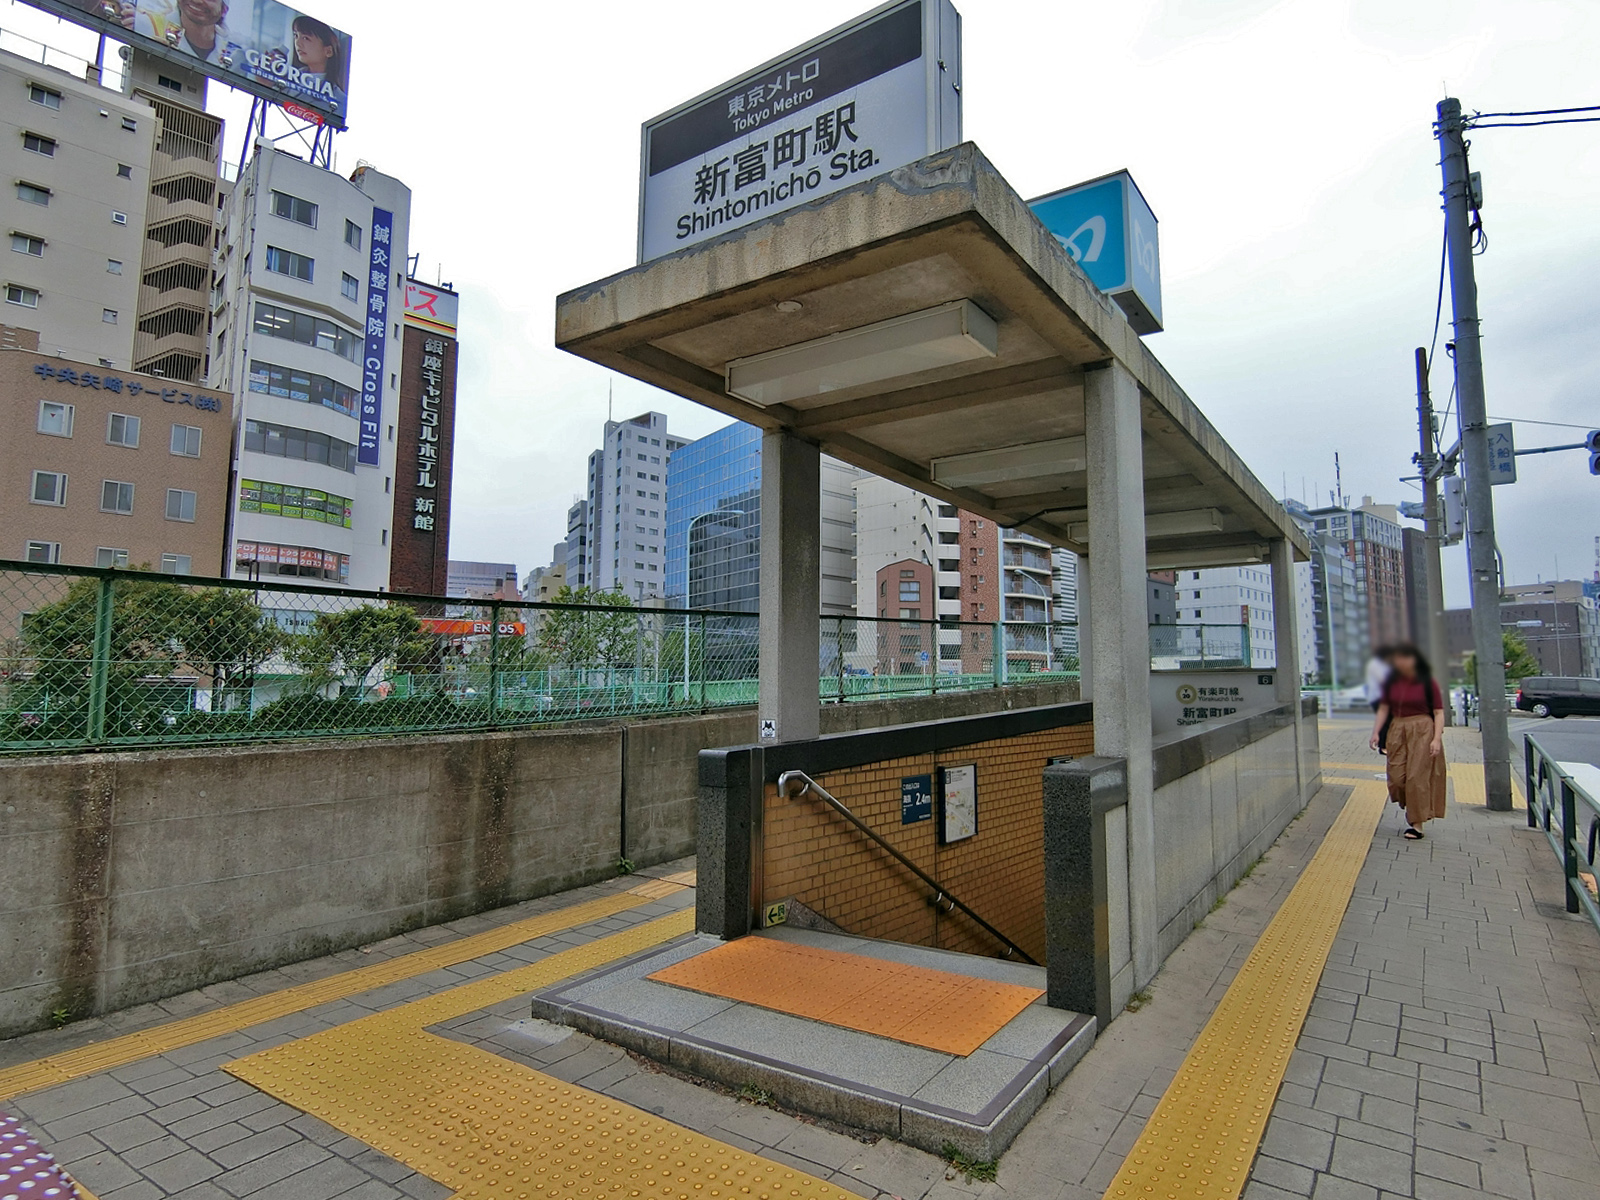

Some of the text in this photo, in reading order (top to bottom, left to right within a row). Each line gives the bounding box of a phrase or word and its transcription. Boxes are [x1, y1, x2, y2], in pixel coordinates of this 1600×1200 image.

[245, 49, 335, 98] GEORGIA
[727, 58, 820, 118] 東京メトロ
[732, 87, 814, 132] Tokyo Metro
[693, 101, 859, 205] 新富町駅
[676, 149, 880, 240] Shintomichō Sta.
[361, 421, 377, 449] Fit
[414, 497, 435, 531] 新館
[473, 623, 516, 634] ENOS
[1198, 687, 1240, 696] 有楽町線
[1262, 676, 1268, 684] 6
